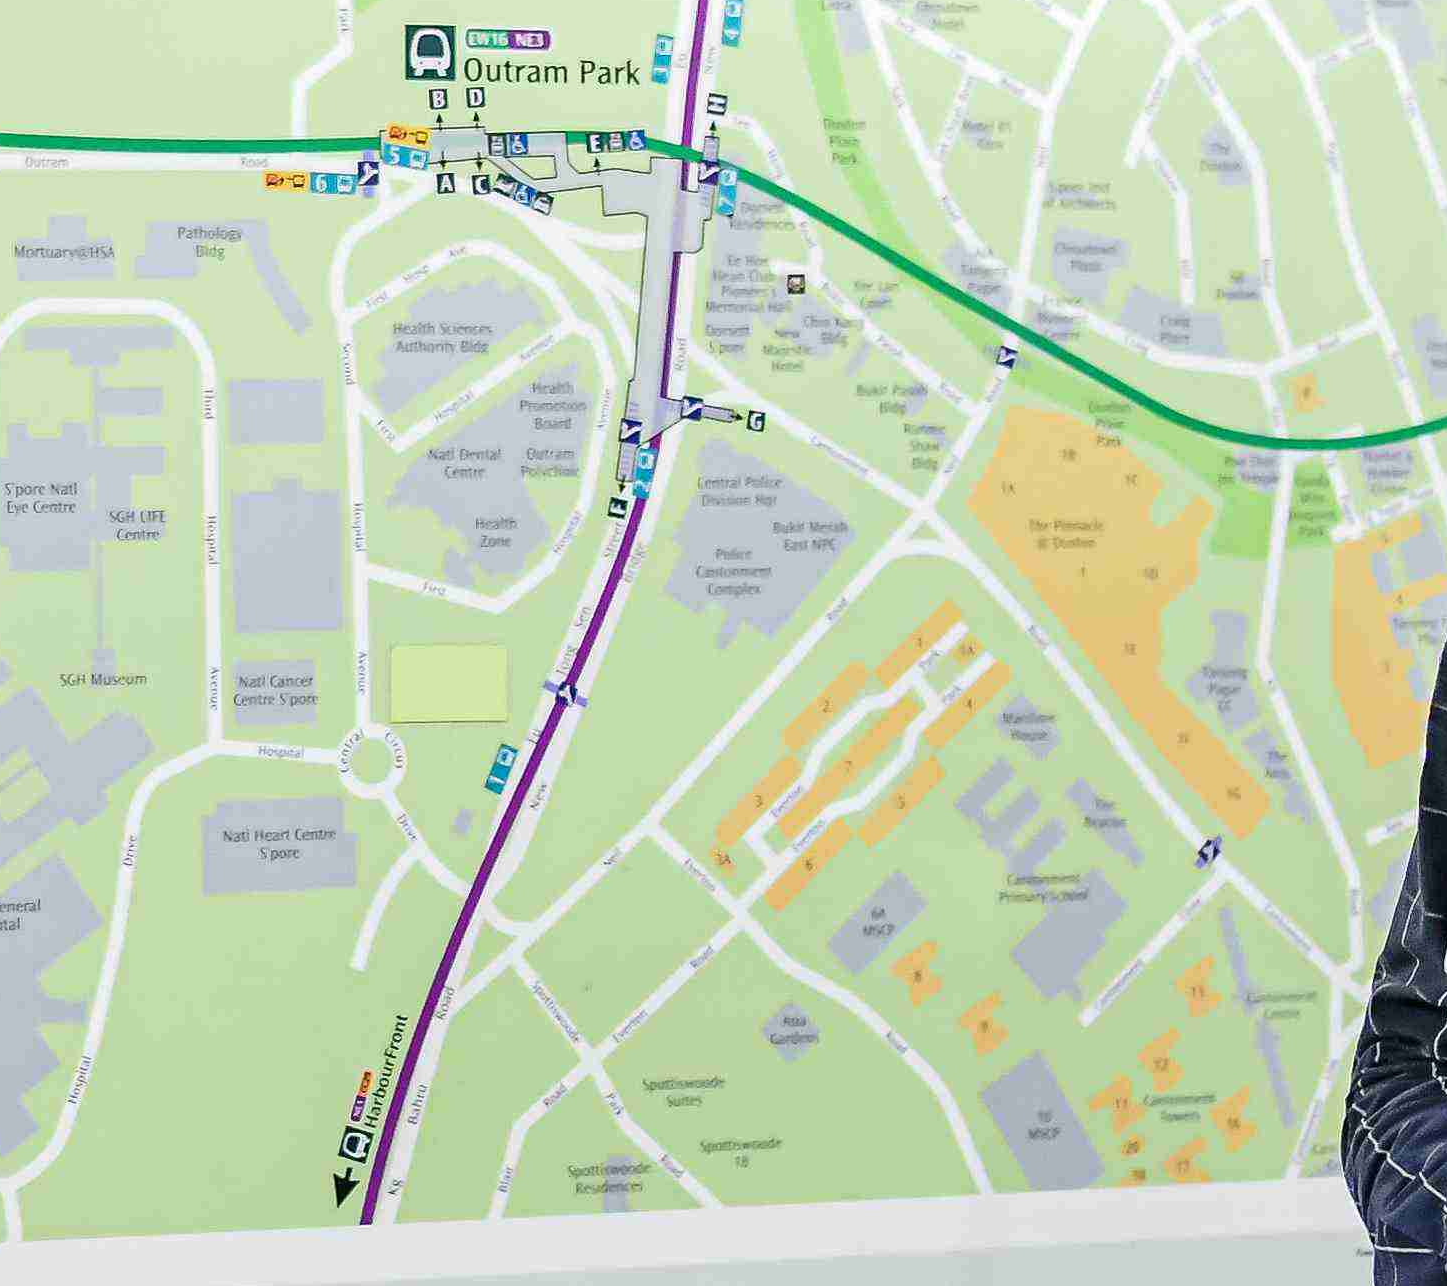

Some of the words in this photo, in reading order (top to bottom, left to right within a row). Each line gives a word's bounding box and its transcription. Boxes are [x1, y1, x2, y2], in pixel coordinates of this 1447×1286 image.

[464, 58, 568, 83] Outram
[580, 59, 641, 85] Park
[433, 91, 446, 106] B
[470, 90, 483, 105] D
[590, 135, 602, 151] E
[440, 176, 453, 192] A
[475, 177, 489, 193] C
[177, 227, 242, 242] Pathology
[364, 1014, 409, 1128] HarbourFront
